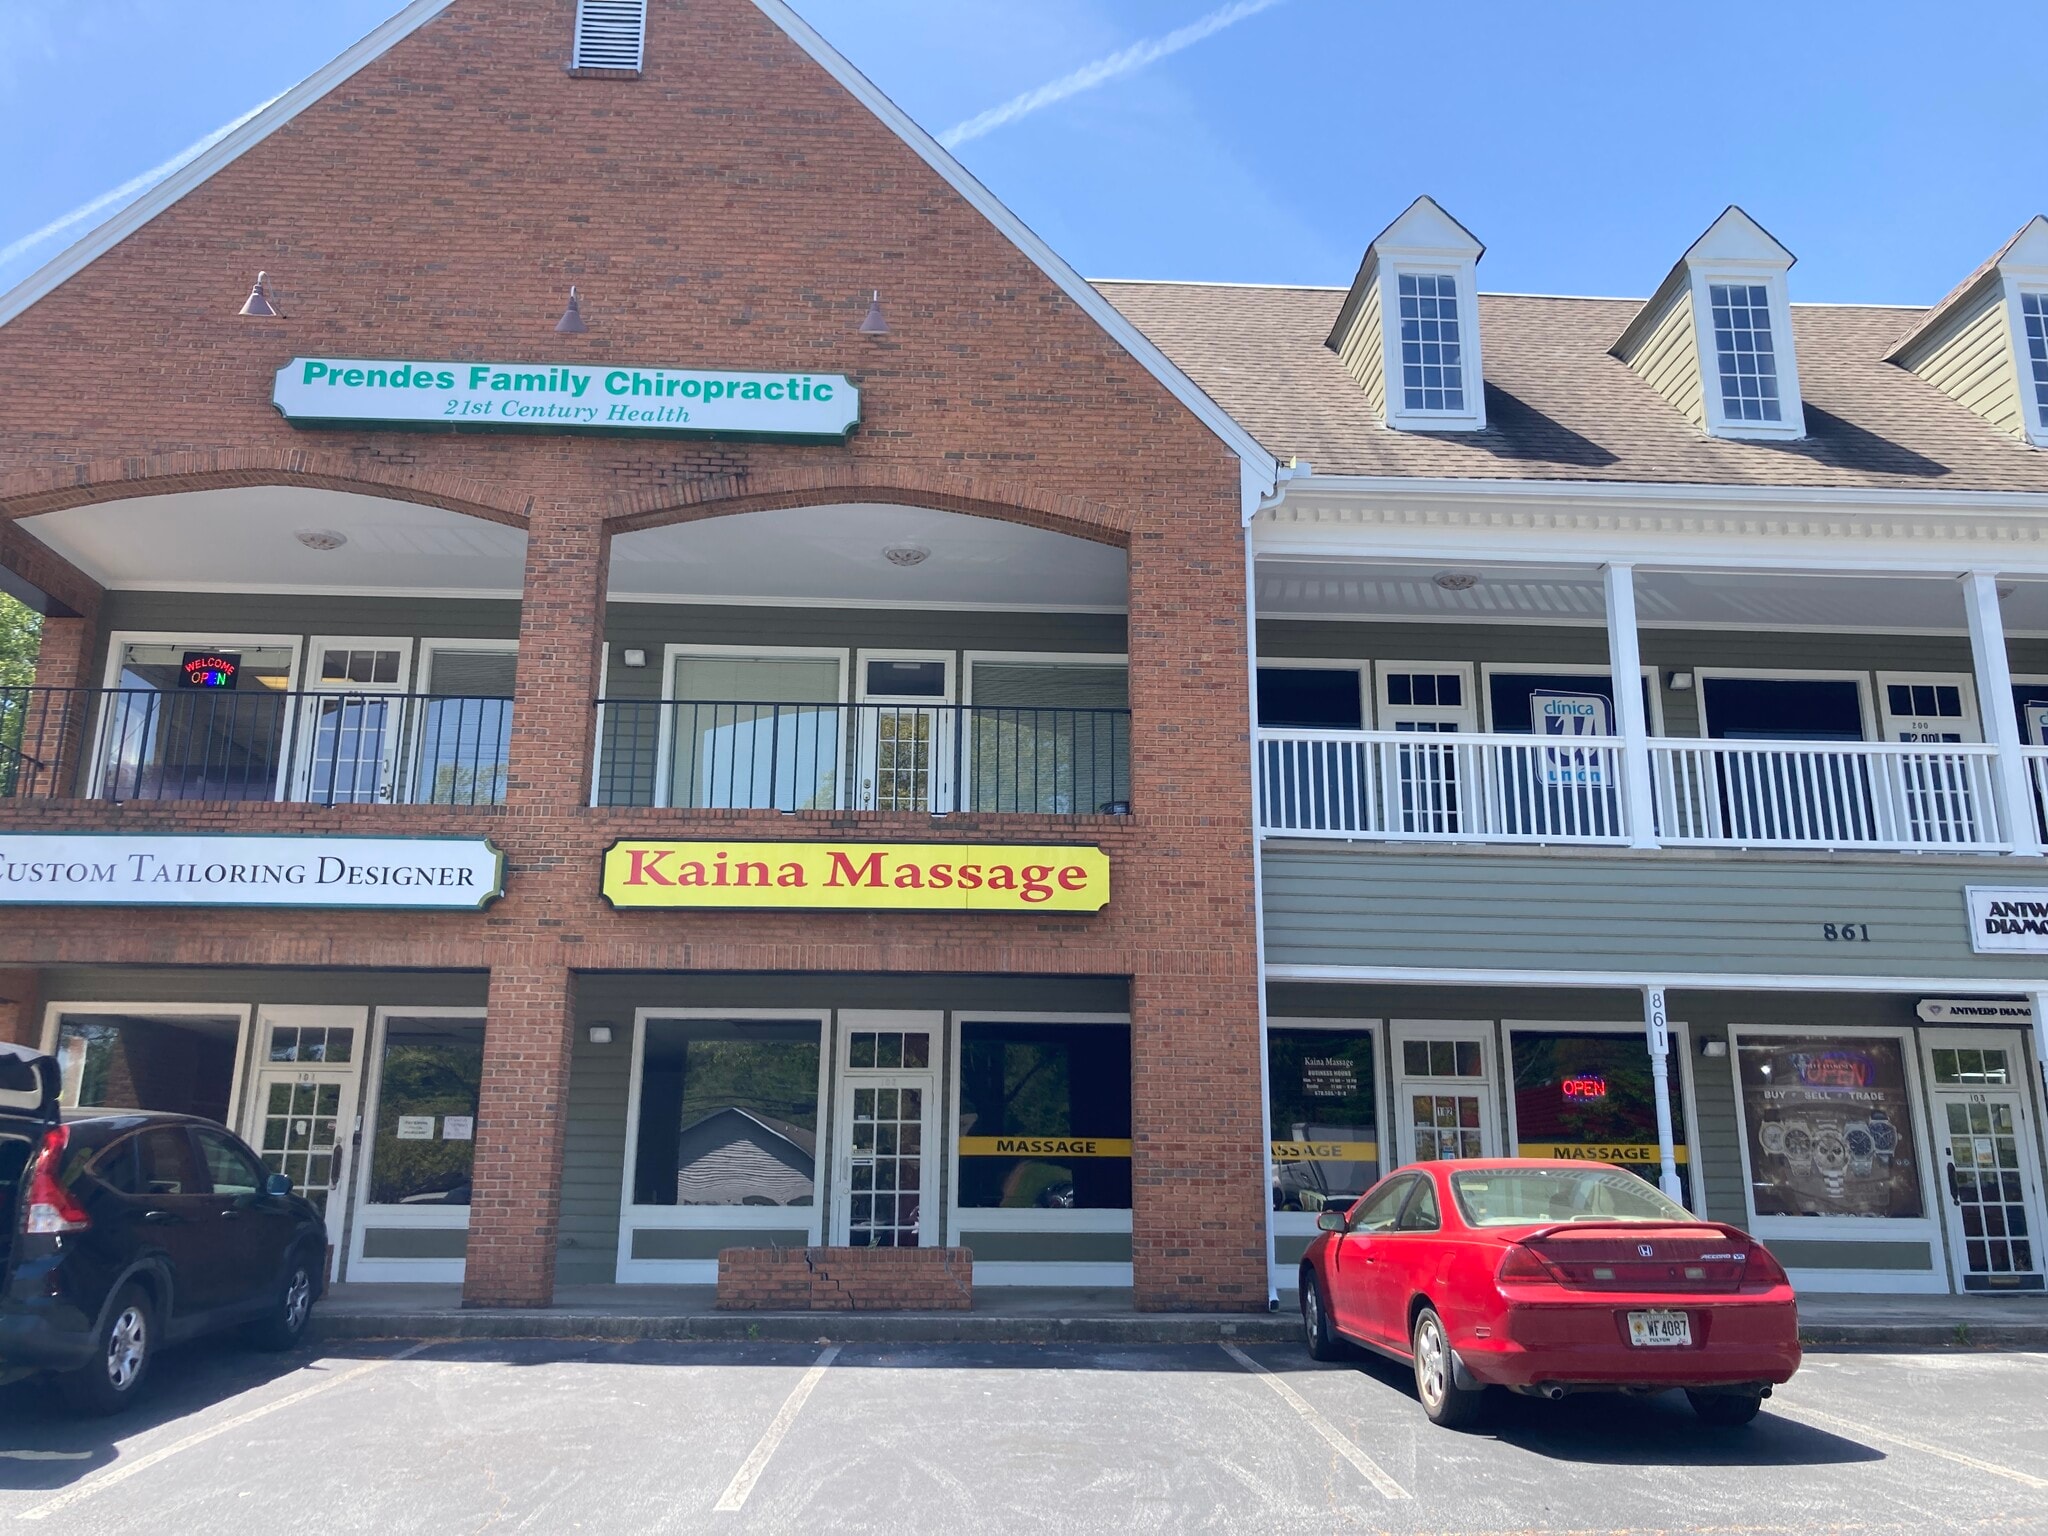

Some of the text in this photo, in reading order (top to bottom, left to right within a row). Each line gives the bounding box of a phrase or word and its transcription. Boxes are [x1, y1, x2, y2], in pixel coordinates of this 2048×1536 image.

[302, 361, 834, 403] Prendes Family Chiropractic
[444, 400, 691, 423] 21st Century Health
[184, 657, 235, 675] WELCOME
[191, 671, 227, 685] OPEN
[1543, 700, 1595, 716] clínica
[1549, 767, 1601, 782] unón
[0, 853, 474, 887] USTOM TAILORING DESIGNER
[622, 849, 1088, 903] Kaina Massage
[1823, 922, 1871, 942] 861
[1949, 1006, 1998, 1016] ANTWERP
[1652, 993, 1664, 1047] 861
[1304, 1057, 1354, 1068] Kaina Massage
[1563, 1081, 1606, 1096] OPEN
[1764, 1091, 1786, 1099] BUY
[1849, 1093, 1885, 1101] TRADE
[997, 1140, 1096, 1153] MASSAGE
[1271, 1145, 1342, 1157] SSAGE
[1554, 1147, 1650, 1160] MASSAGE
